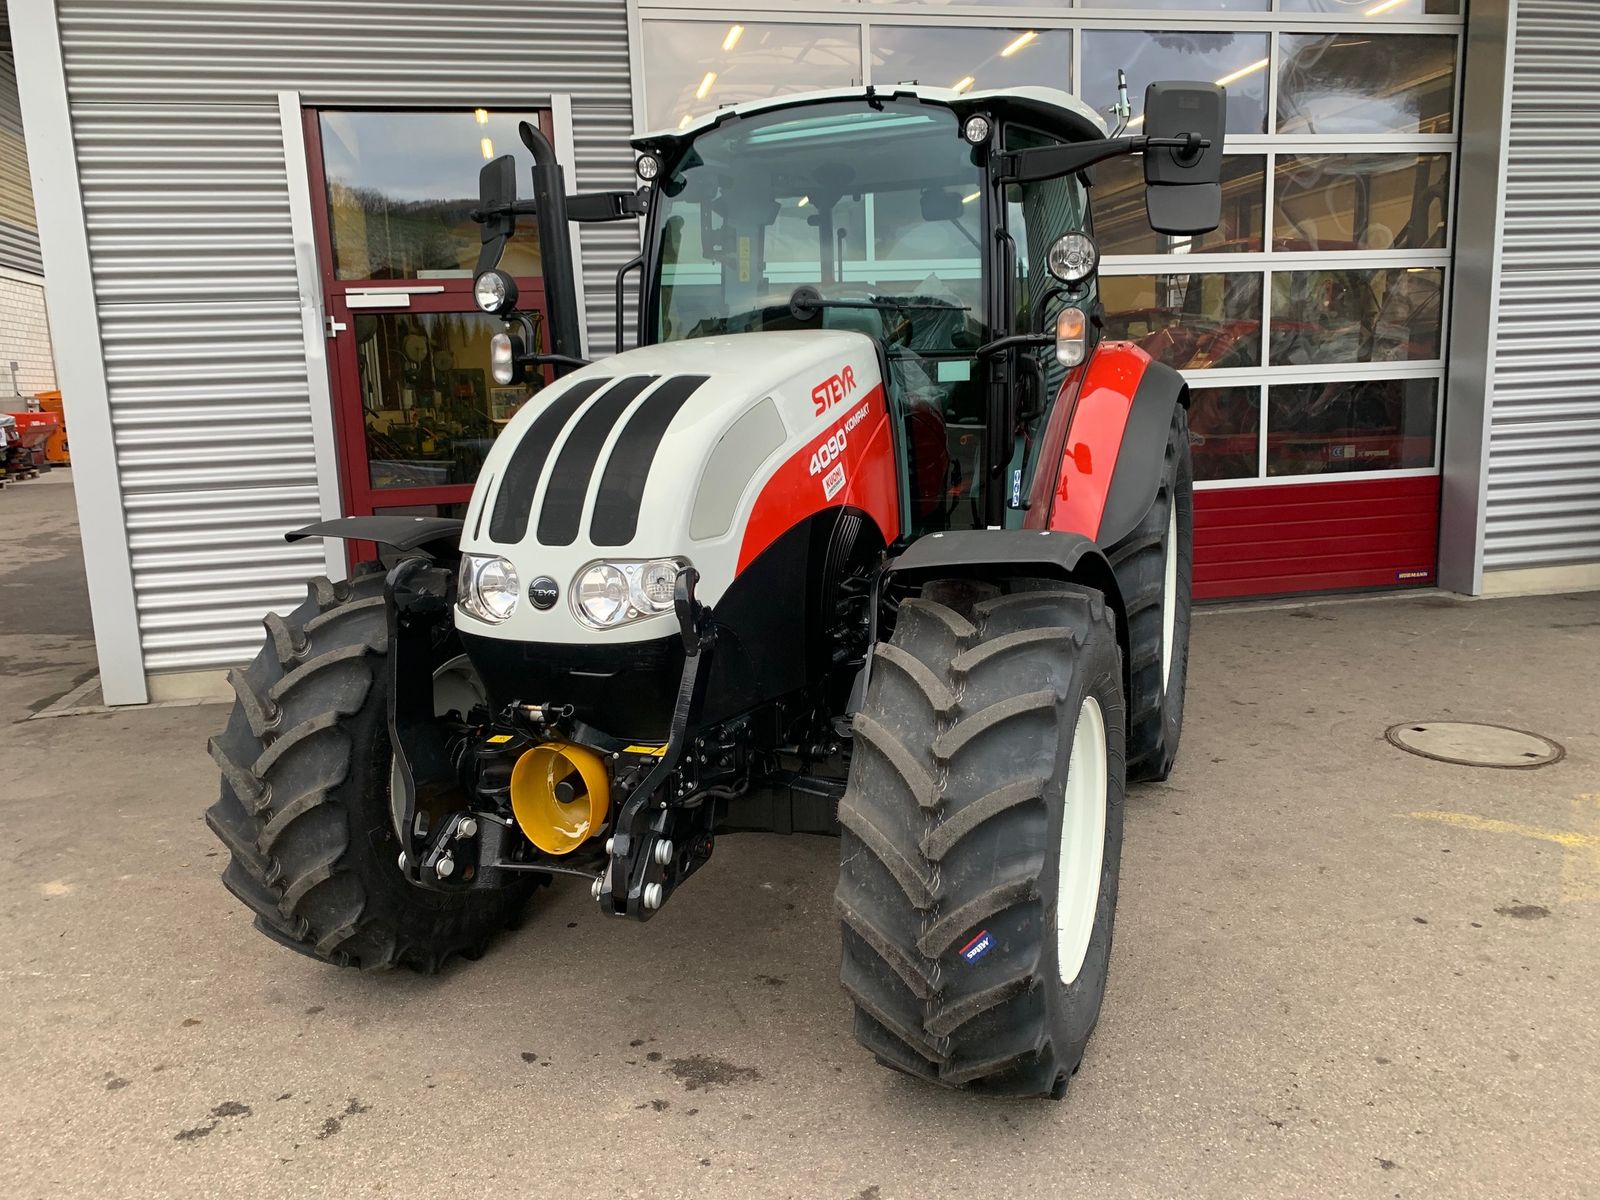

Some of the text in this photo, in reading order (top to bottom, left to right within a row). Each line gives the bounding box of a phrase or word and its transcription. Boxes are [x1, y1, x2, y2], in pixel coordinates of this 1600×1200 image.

[811, 365, 857, 417] STEYR
[809, 428, 848, 477] 4090
[844, 402, 870, 434] KOMPAKT
[529, 589, 557, 598] STEYR
[966, 937, 989, 959] Mitas
